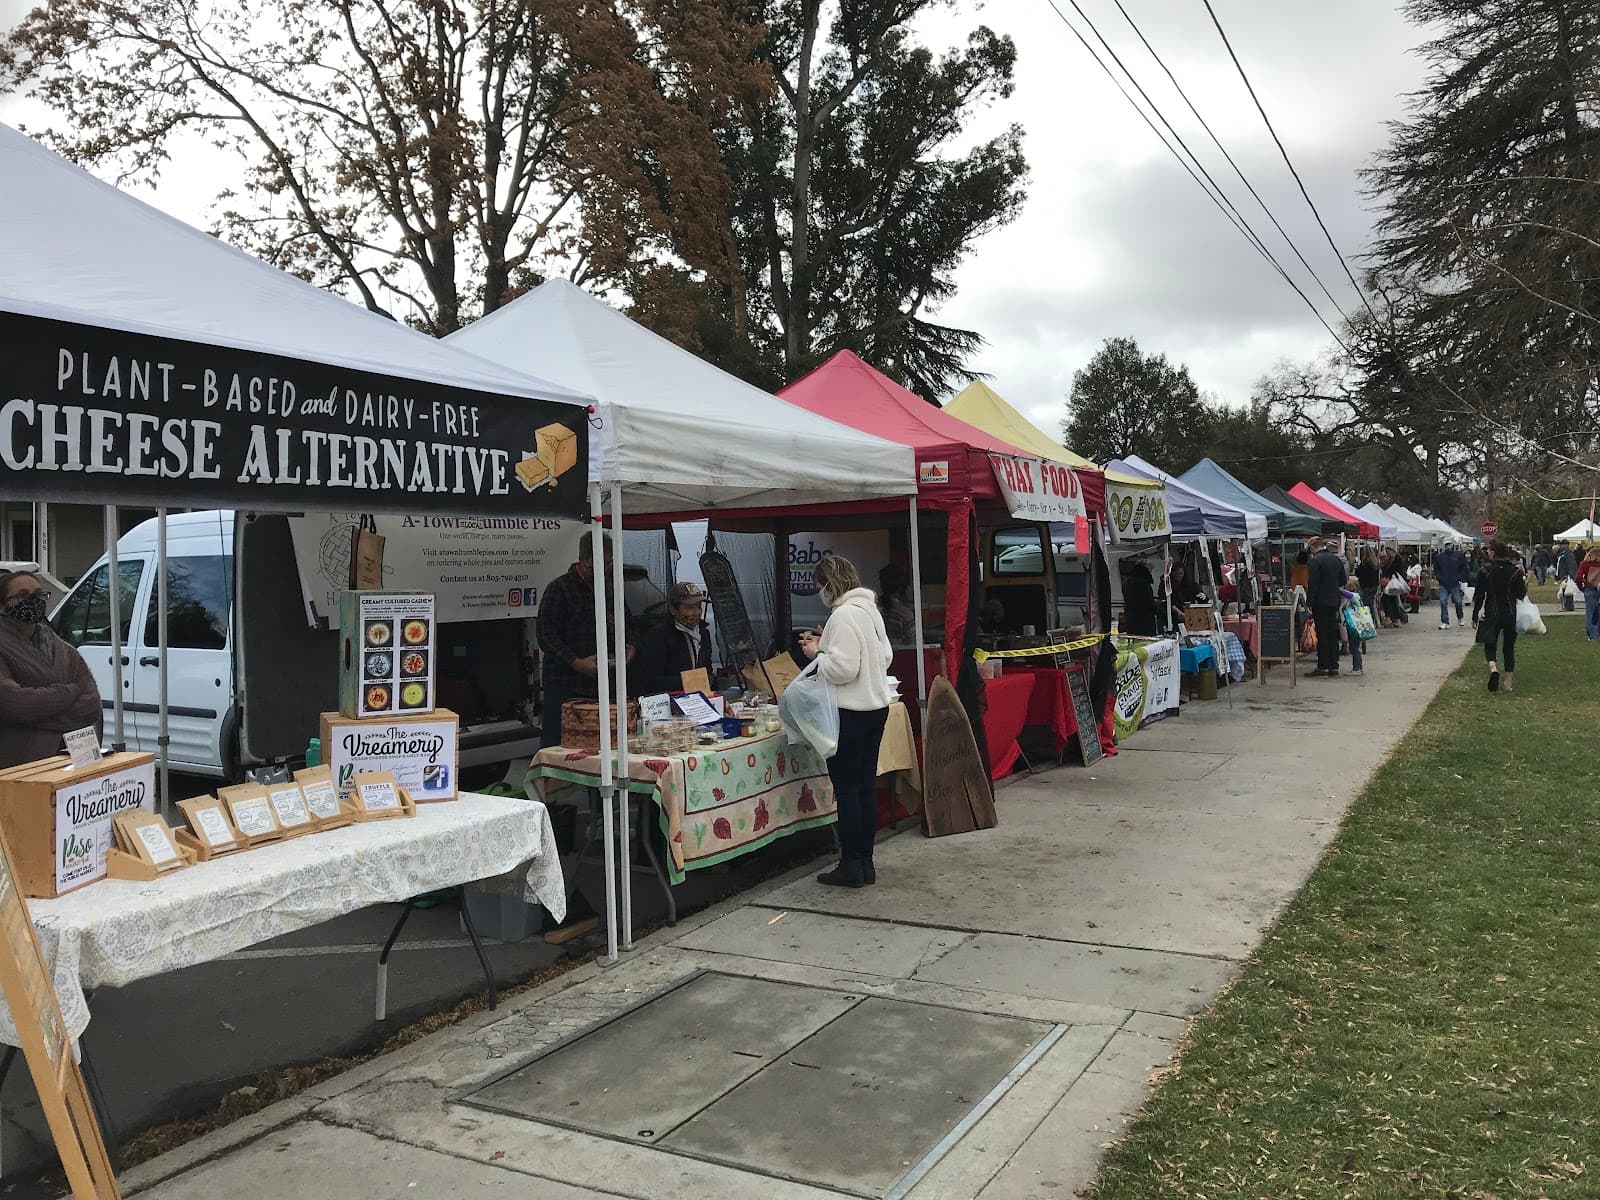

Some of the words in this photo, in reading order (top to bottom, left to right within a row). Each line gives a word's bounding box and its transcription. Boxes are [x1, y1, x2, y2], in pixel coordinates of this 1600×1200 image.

[58, 348, 296, 418] PLANT-BASED
[300, 386, 338, 418] and
[345, 389, 480, 438] DAIRY-FREE
[0, 398, 222, 479] CHEESE
[236, 425, 510, 496] ALTERNATIVE
[1041, 464, 1078, 499] FOOD
[483, 517, 529, 530] umble
[533, 518, 561, 530] Pies
[422, 548, 437, 556] Visit
[440, 575, 467, 583] Contact
[387, 726, 407, 739] The
[343, 734, 444, 763] Vreamery
[102, 779, 117, 794] The
[66, 781, 145, 825] Vreamery
[62, 833, 92, 868] Paso
